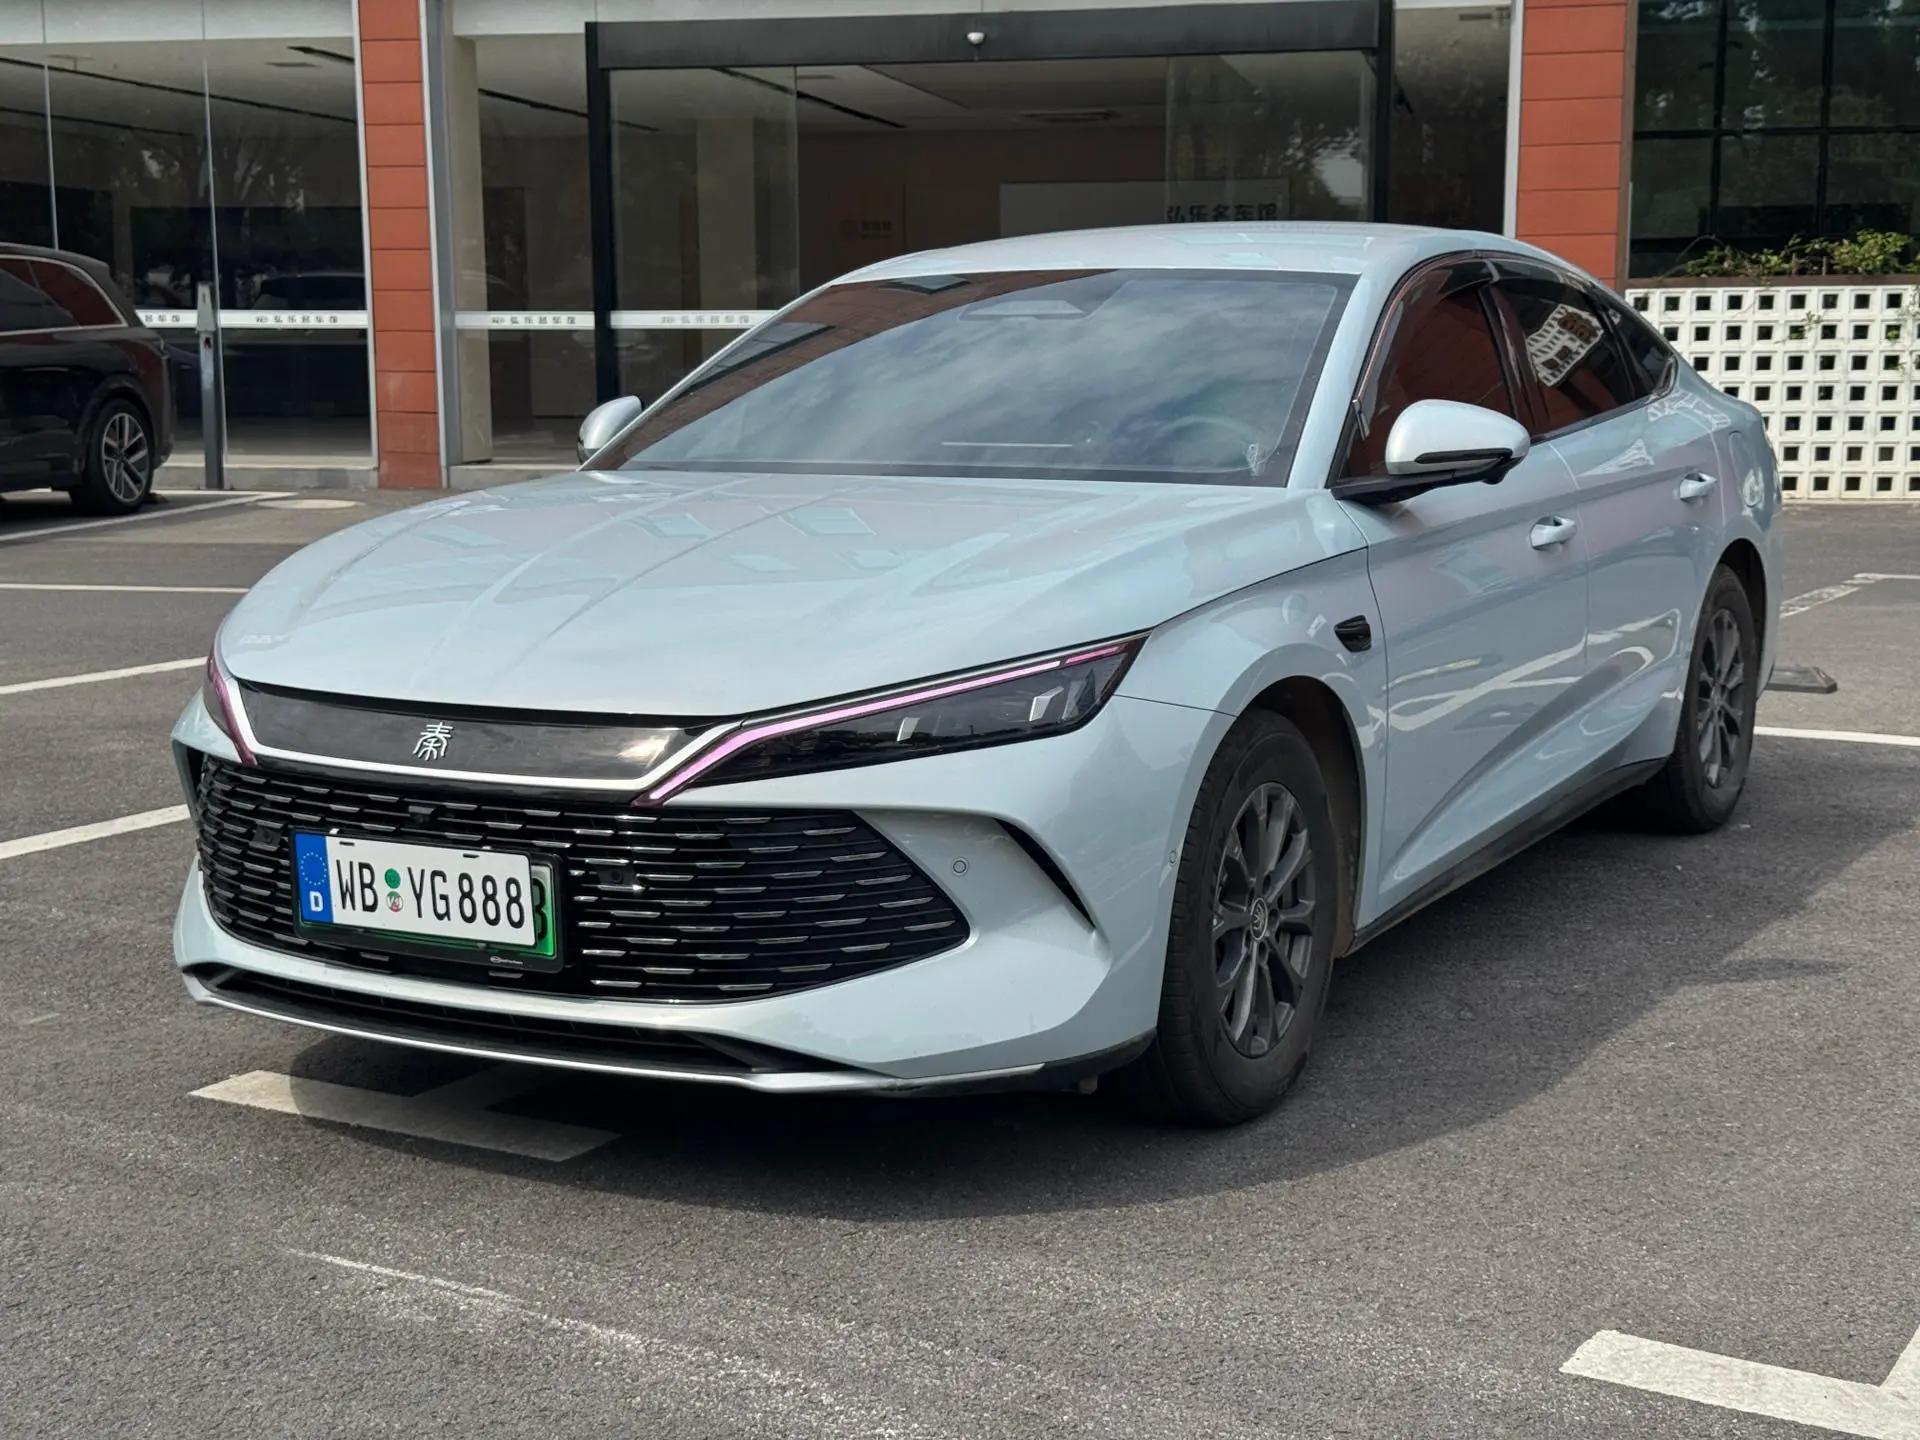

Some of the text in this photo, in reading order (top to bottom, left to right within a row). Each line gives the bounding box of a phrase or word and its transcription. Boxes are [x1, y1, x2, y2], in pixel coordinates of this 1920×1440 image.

[309, 890, 324, 912] D
[335, 859, 379, 913] WB
[407, 866, 525, 929] YG888
